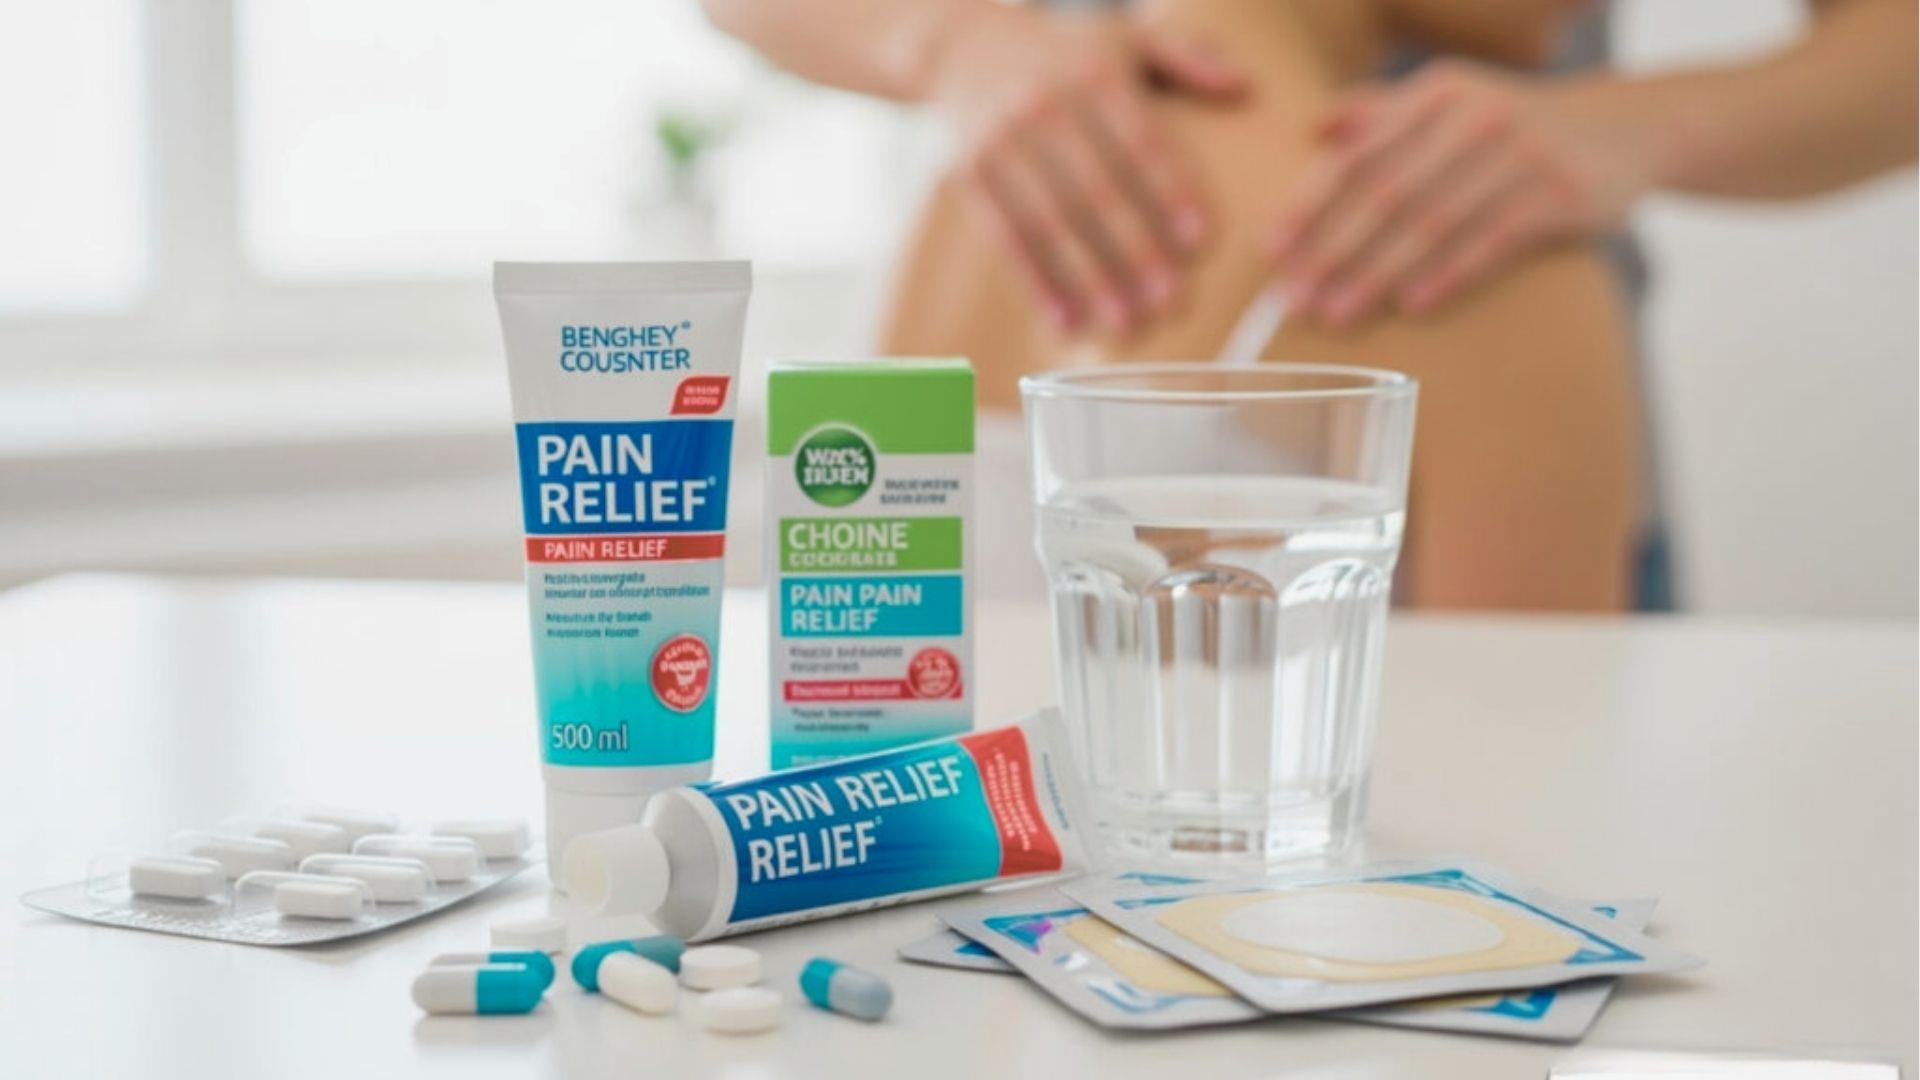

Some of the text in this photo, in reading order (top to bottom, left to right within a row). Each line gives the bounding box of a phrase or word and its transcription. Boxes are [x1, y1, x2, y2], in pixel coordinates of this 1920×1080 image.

[560, 348, 690, 373] COUSNTER
[537, 433, 653, 476] PAIN
[540, 479, 708, 524] RELIEF
[601, 538, 668, 558] RELIEF
[788, 522, 909, 550] CHOINE
[790, 583, 923, 607] PAIN PAIN
[791, 607, 879, 632] RELIEF
[552, 722, 629, 750] 500 ml
[727, 781, 835, 830] PAIN
[835, 756, 964, 813] RELIEF
[748, 820, 878, 883] RELIEF
